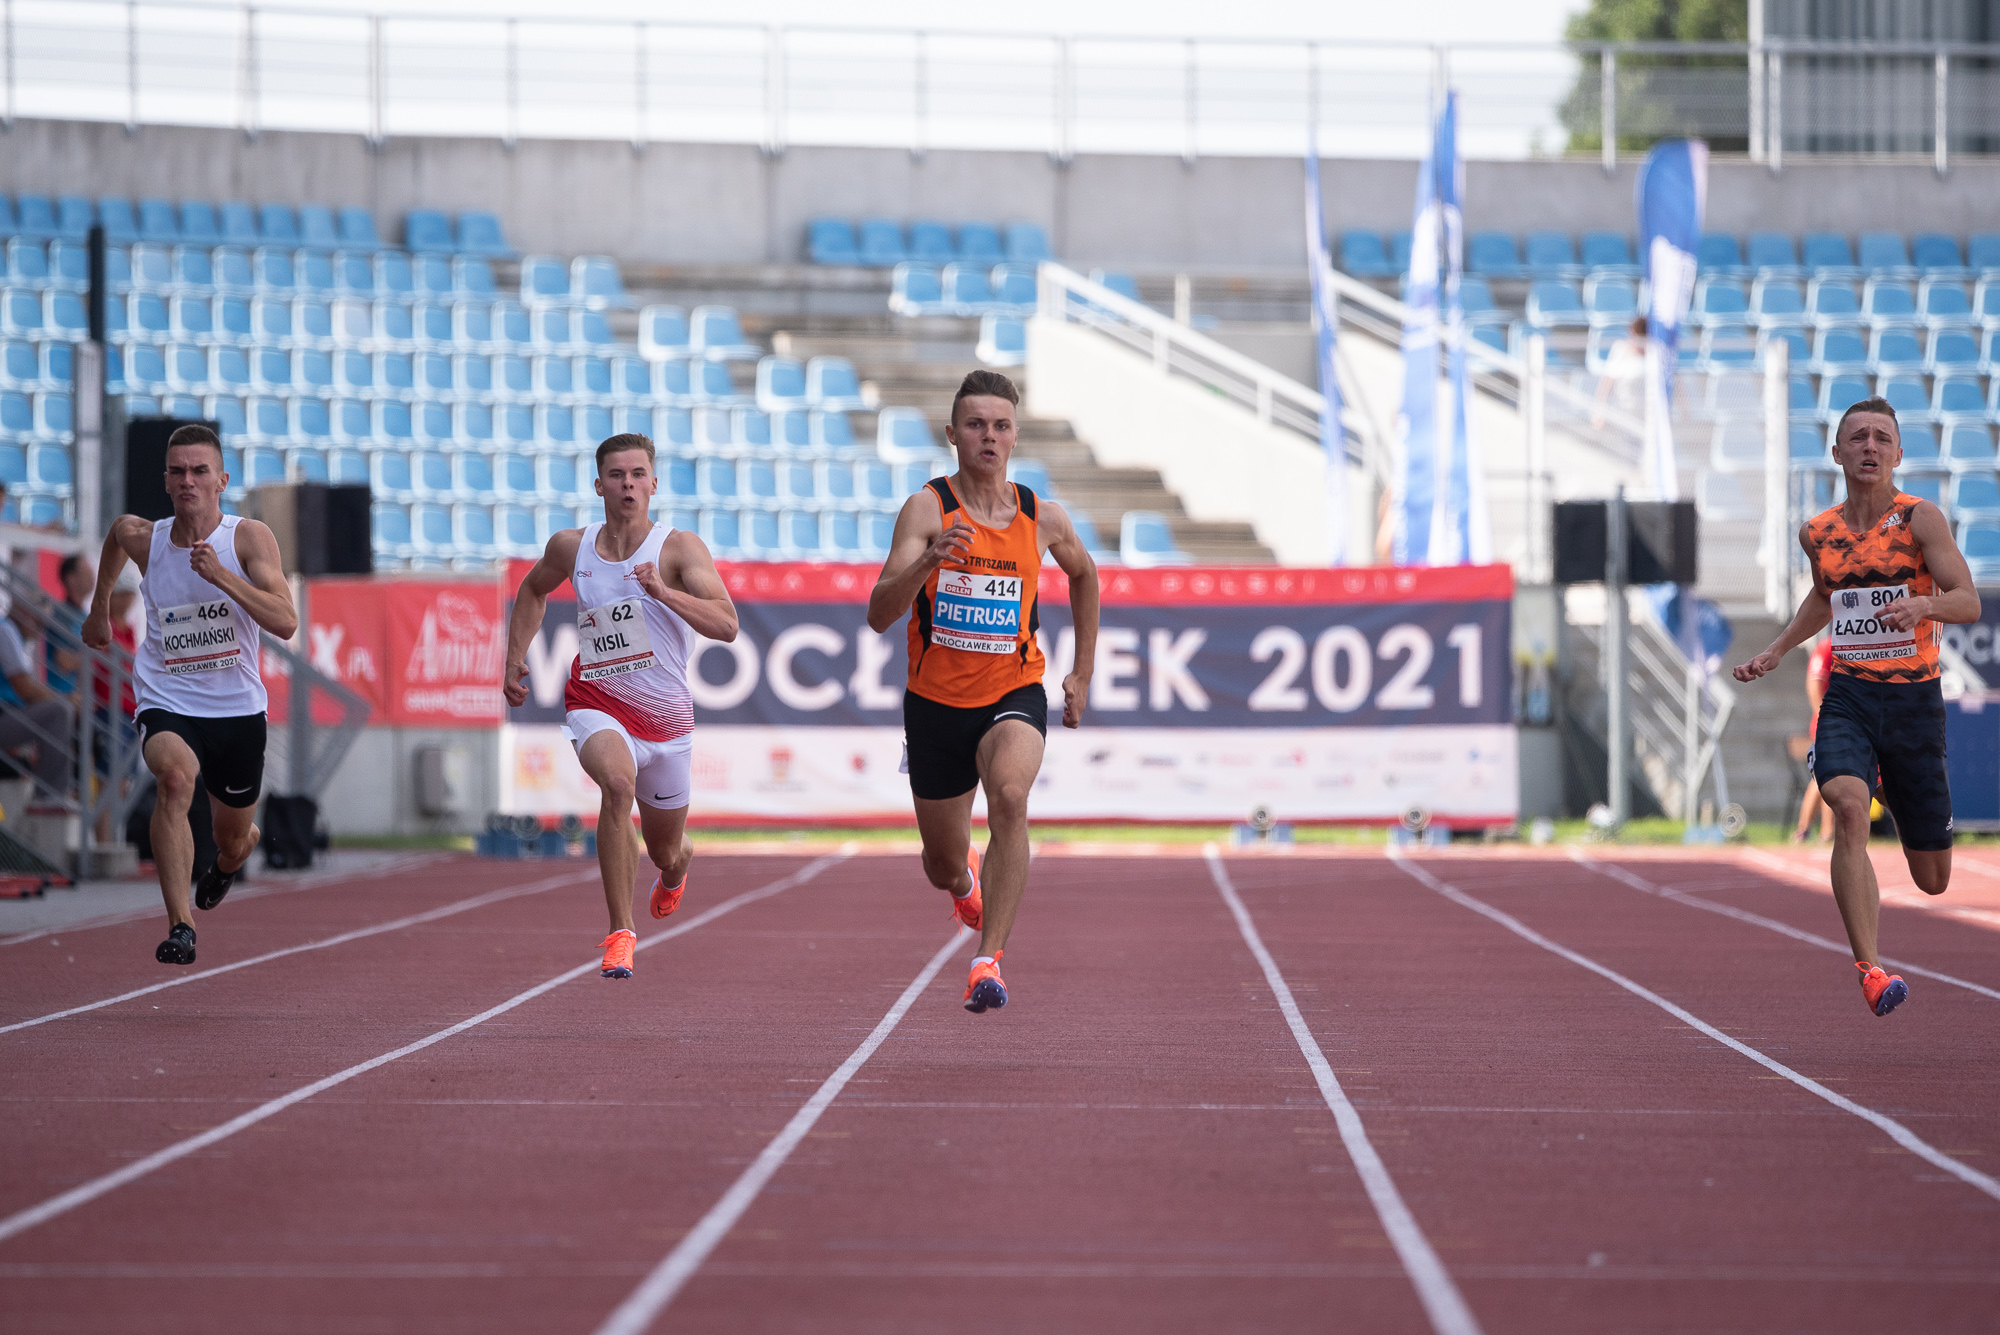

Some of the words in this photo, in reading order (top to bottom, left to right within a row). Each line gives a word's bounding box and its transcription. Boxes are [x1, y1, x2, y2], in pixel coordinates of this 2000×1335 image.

[945, 585, 971, 595] ORLEN
[984, 579, 1016, 597] 414
[198, 602, 229, 620] 466
[612, 604, 634, 622] 62
[937, 601, 1017, 626] PIETRUSA
[164, 626, 235, 652] KOCHMAŃSKI
[593, 632, 630, 654] KISIL
[935, 634, 992, 651] WŁOCŁAWEK
[994, 643, 1012, 652] 2021
[1834, 650, 1891, 661] WŁOCŁAWEK
[1892, 647, 1912, 657] 2021
[170, 661, 218, 674] WŁOCŁAWEK
[219, 657, 238, 667] 2021
[584, 664, 631, 679] WŁOCŁAWEK
[632, 659, 652, 671] 2021
[1249, 623, 1484, 713] 2021
